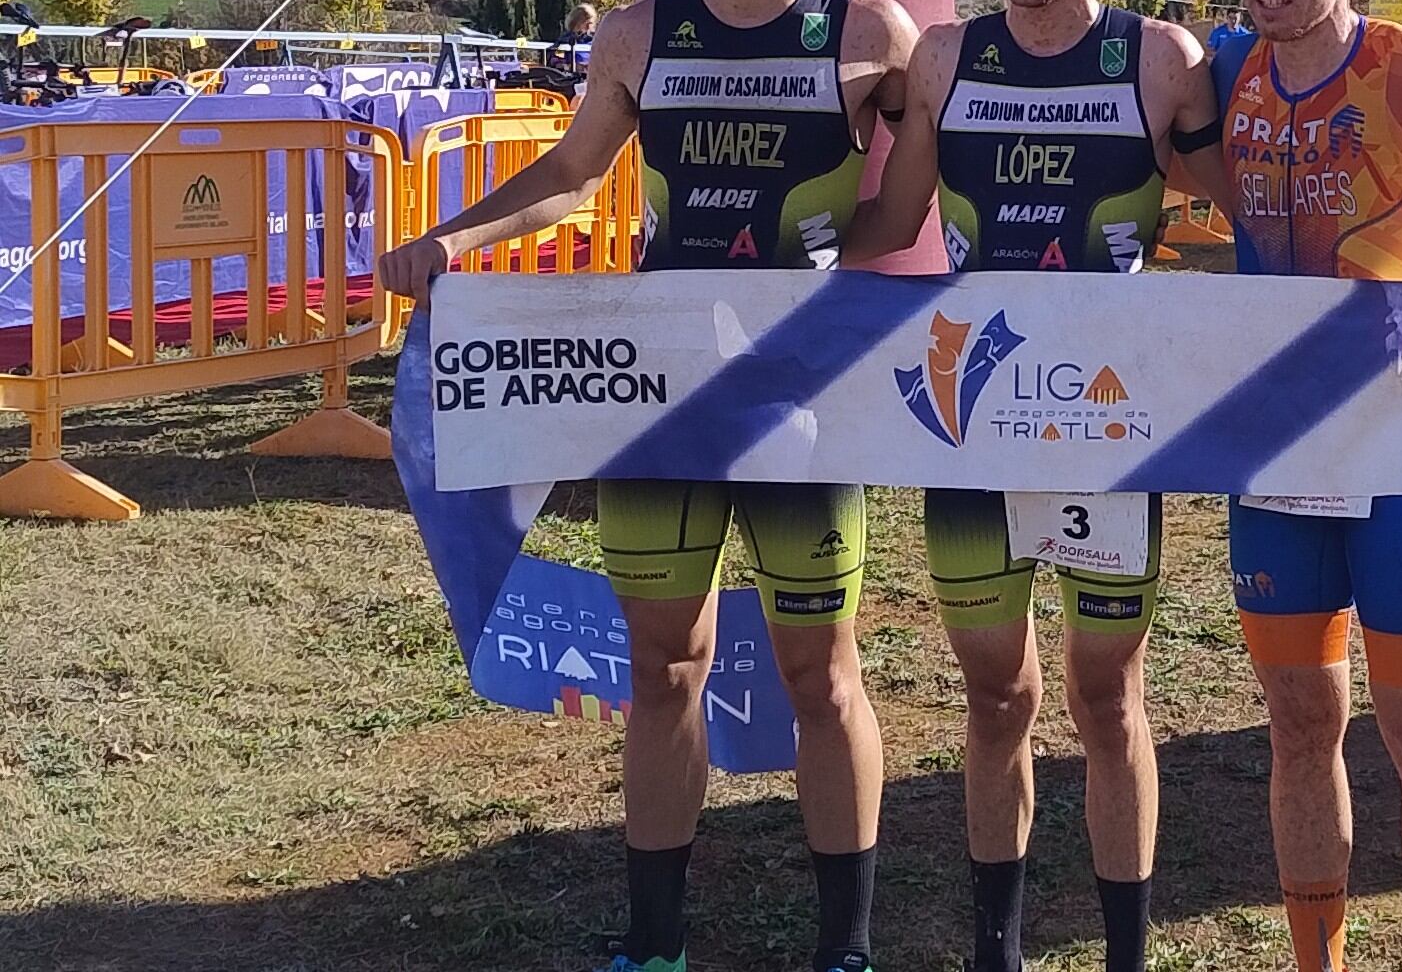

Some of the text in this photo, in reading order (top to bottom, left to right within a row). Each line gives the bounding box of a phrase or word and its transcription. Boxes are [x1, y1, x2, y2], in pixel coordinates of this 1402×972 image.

[662, 75, 816, 98] STADIUM CASABLANCA
[966, 99, 1119, 123] STADIUM CASABLANCA
[680, 121, 788, 168] ALVAREZ
[1231, 112, 1326, 147] PRAT
[995, 136, 1076, 185] LÓPEZ
[686, 187, 759, 209] MAPEI
[1241, 163, 1357, 217] SELLARÉS
[997, 204, 1065, 224] MAPEI
[435, 338, 637, 375] GOBIERNO
[436, 373, 667, 411] DE ARAGON
[1014, 363, 1130, 406] LIGA
[990, 421, 1152, 441] TRIATLON
[1062, 505, 1091, 540] 3
[1058, 544, 1121, 562] DORSALIA
